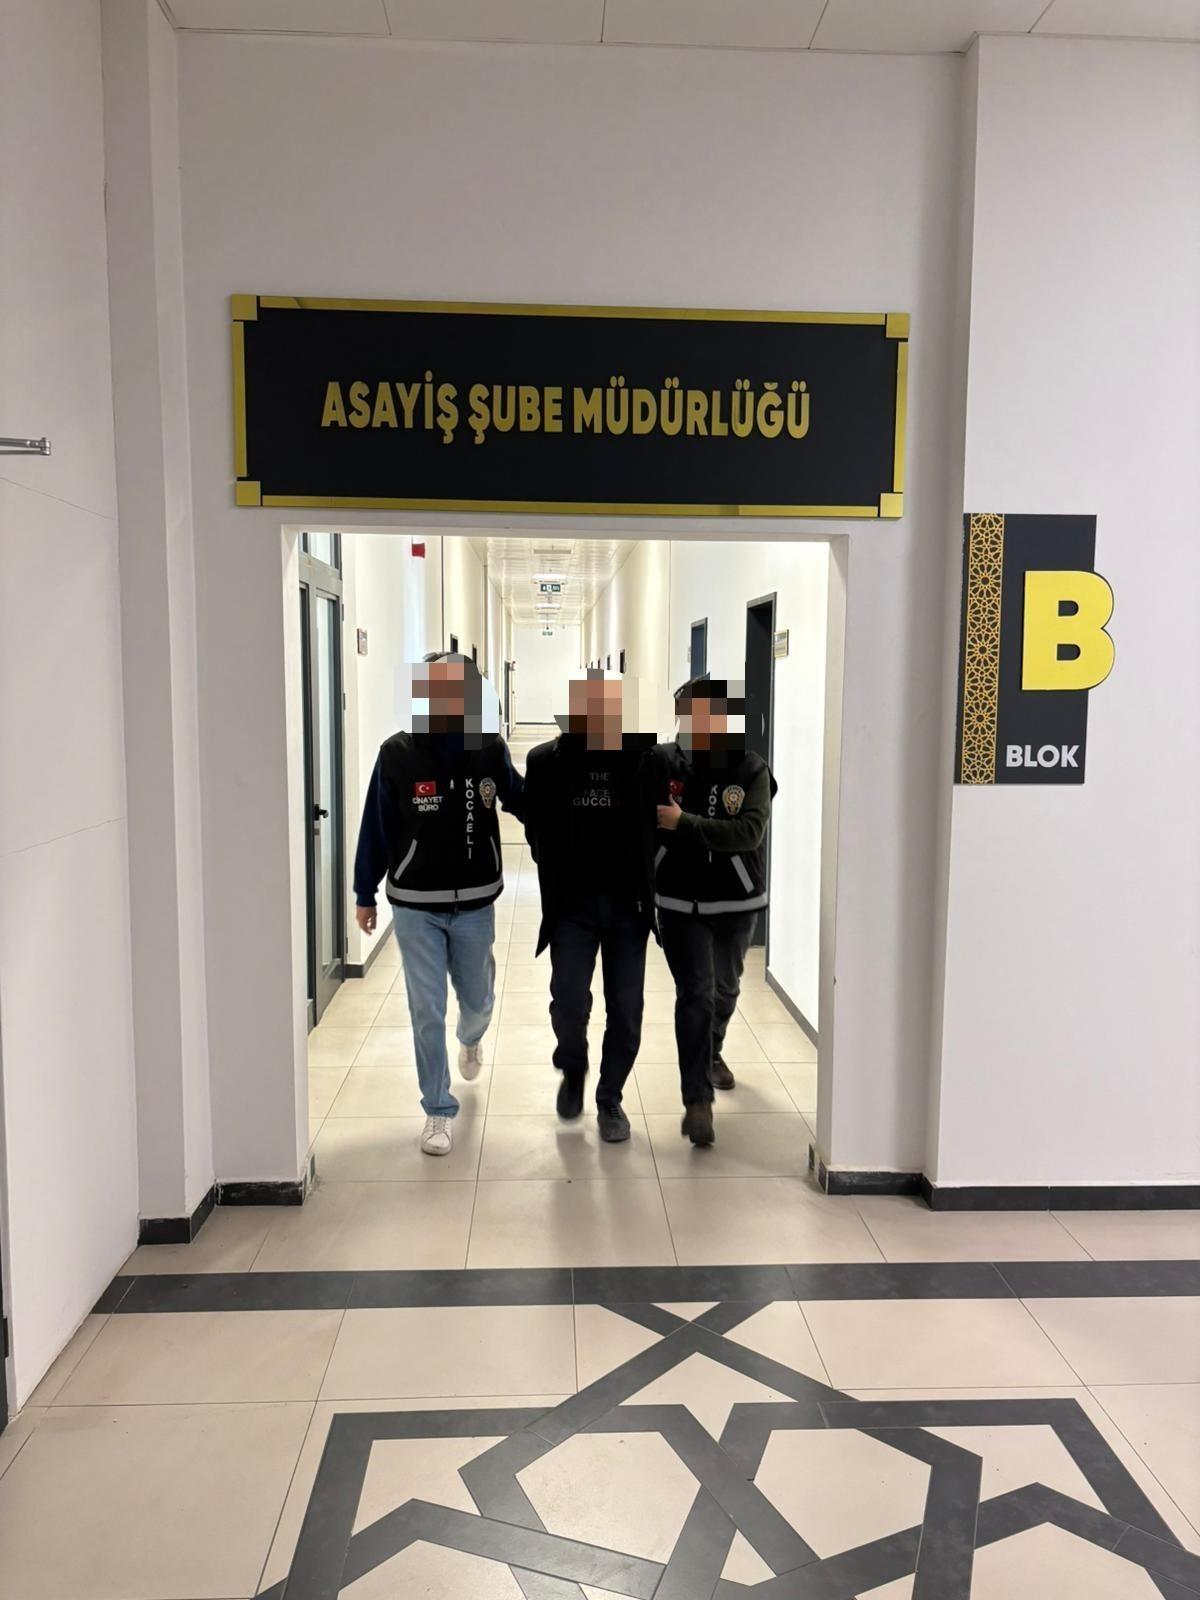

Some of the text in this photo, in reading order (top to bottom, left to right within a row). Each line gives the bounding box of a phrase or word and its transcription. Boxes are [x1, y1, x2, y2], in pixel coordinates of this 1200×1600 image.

[321, 370, 810, 445] ASAYİŞ ŞUBE MÜDÜRLÜĞÜ
[1022, 570, 1115, 691] B
[1005, 744, 1080, 768] BLOK
[588, 772, 611, 781] THE
[572, 797, 611, 807] GUCCI
